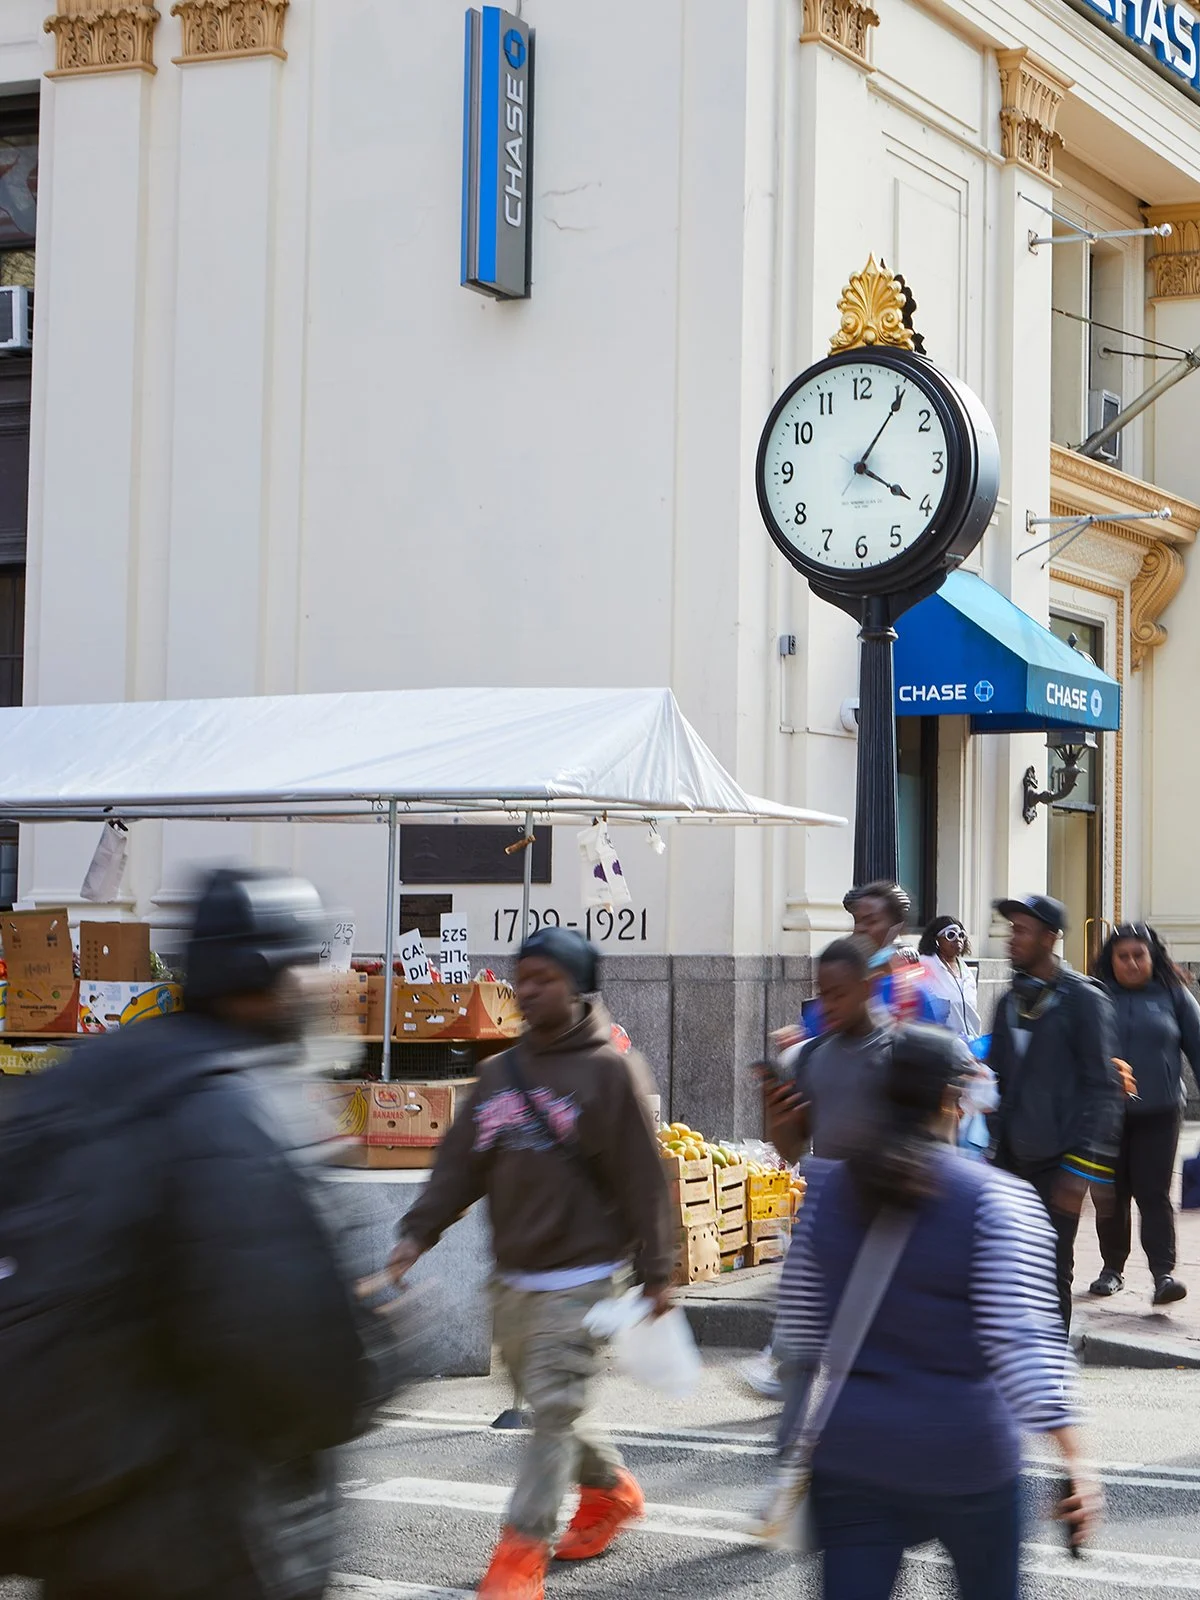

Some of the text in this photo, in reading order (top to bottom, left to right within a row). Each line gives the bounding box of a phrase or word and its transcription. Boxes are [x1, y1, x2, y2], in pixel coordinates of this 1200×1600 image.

[504, 73, 524, 228] CHASE
[853, 377, 873, 400] 12
[819, 392, 833, 415] 11
[918, 409, 931, 432] 2
[794, 421, 813, 445] 10
[782, 461, 794, 484] 9
[932, 451, 943, 474] 3
[794, 502, 807, 525] 8
[919, 494, 932, 517] 4
[822, 529, 833, 551] 7
[855, 536, 868, 558] 6
[890, 525, 901, 548] 5
[899, 684, 967, 702] CHASE
[1046, 682, 1087, 711] CHASE
[402, 943, 424, 961] CA
[373, 1110, 404, 1119] BANANAS
